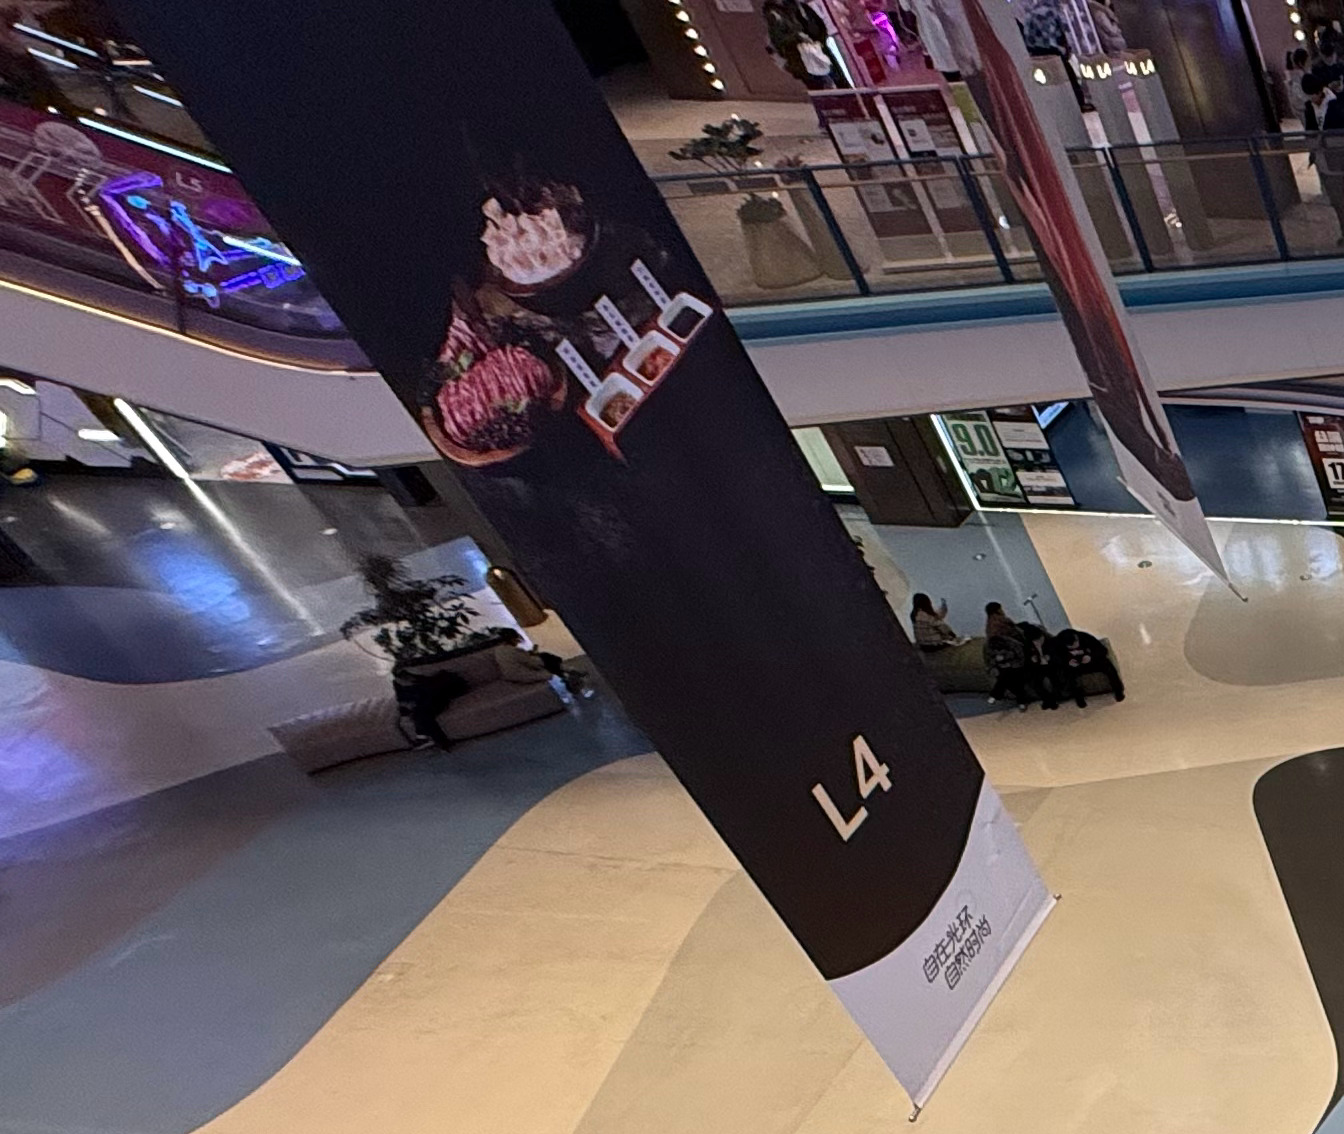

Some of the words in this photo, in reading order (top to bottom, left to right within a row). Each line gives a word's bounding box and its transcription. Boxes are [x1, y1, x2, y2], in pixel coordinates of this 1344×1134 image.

[951, 423, 1000, 457] 9.0
[811, 734, 893, 842] L4
[922, 904, 974, 984] 自在光环
